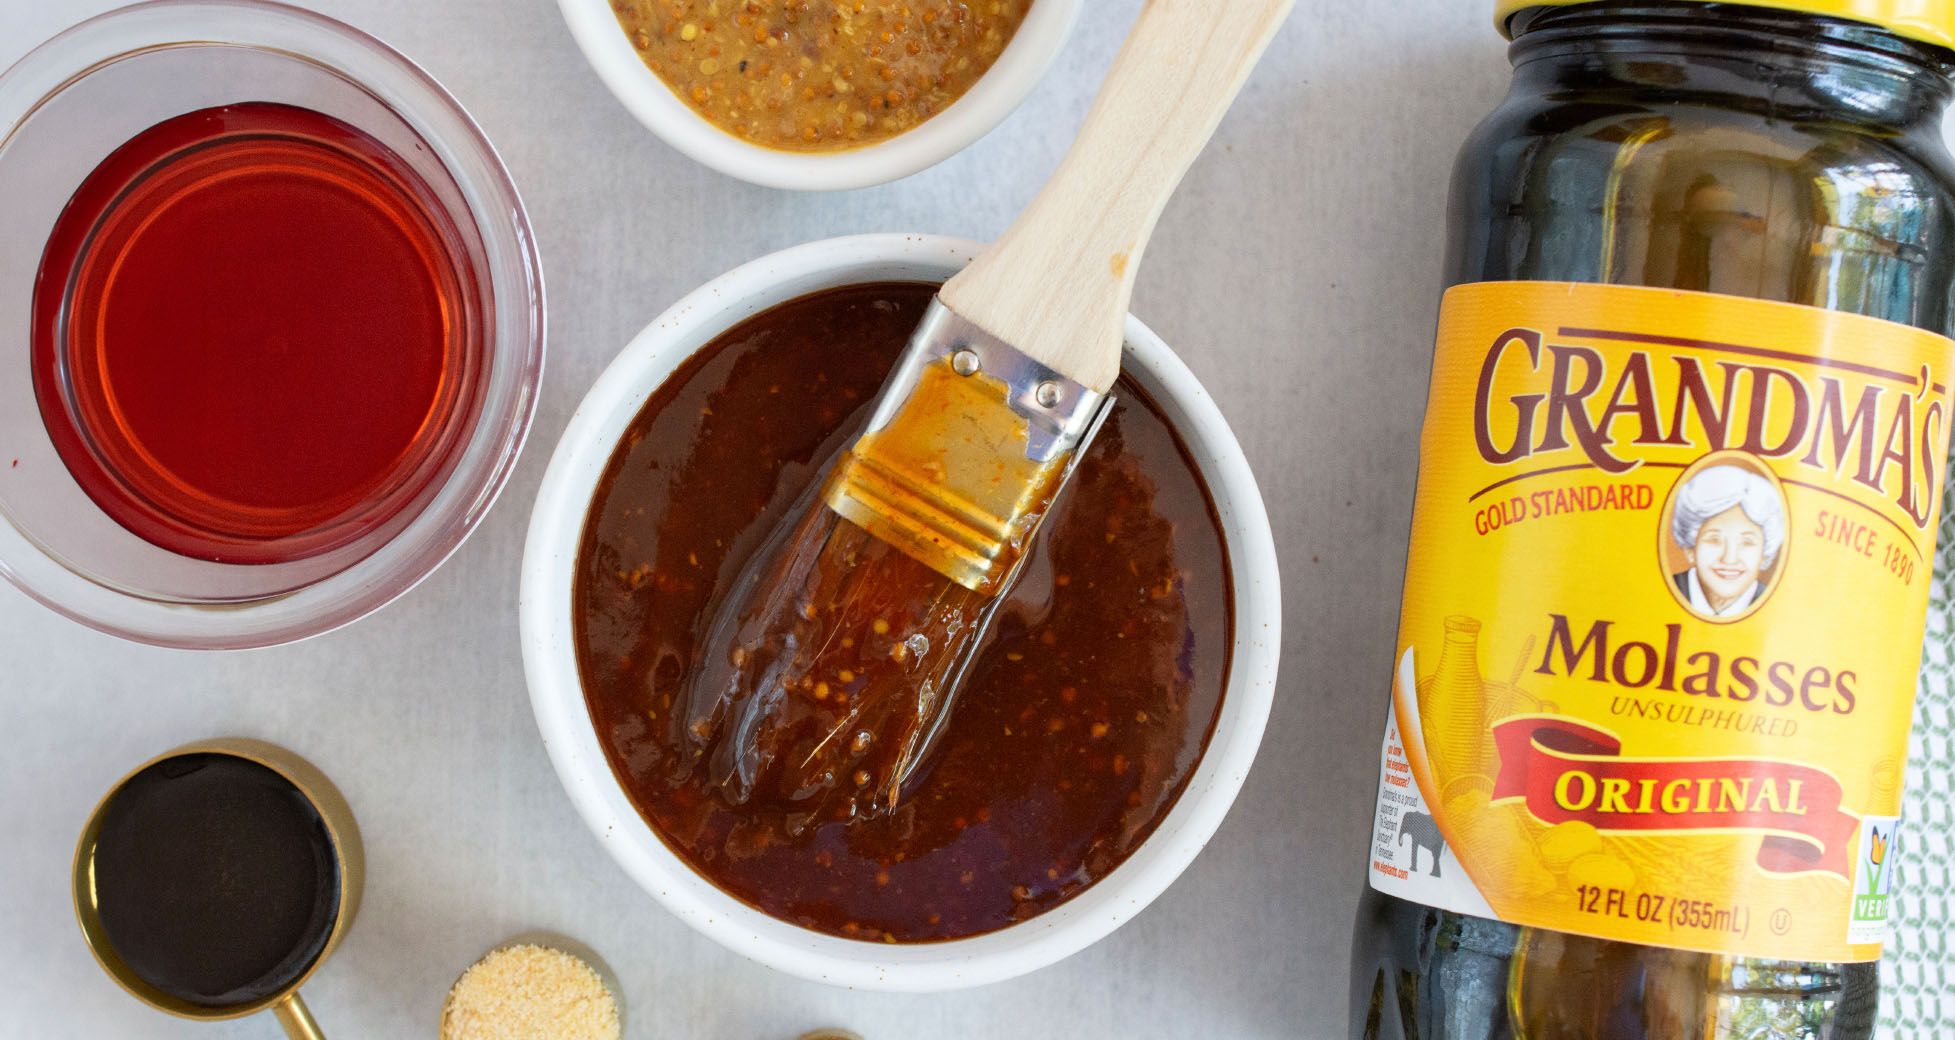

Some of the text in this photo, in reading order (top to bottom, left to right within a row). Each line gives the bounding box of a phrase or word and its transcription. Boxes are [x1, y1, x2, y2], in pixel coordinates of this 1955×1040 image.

[1474, 327, 1943, 529] GRANDMA'S
[1475, 484, 1654, 536] GOLD STANDARD
[1815, 510, 1914, 586] SINCE 1890
[1533, 613, 1857, 715] Molasses
[1610, 696, 1799, 738] UNSULPHURED
[1553, 769, 1808, 816] ORIGINAL
[1576, 884, 1750, 940] 12 FL OZ (355mL)
